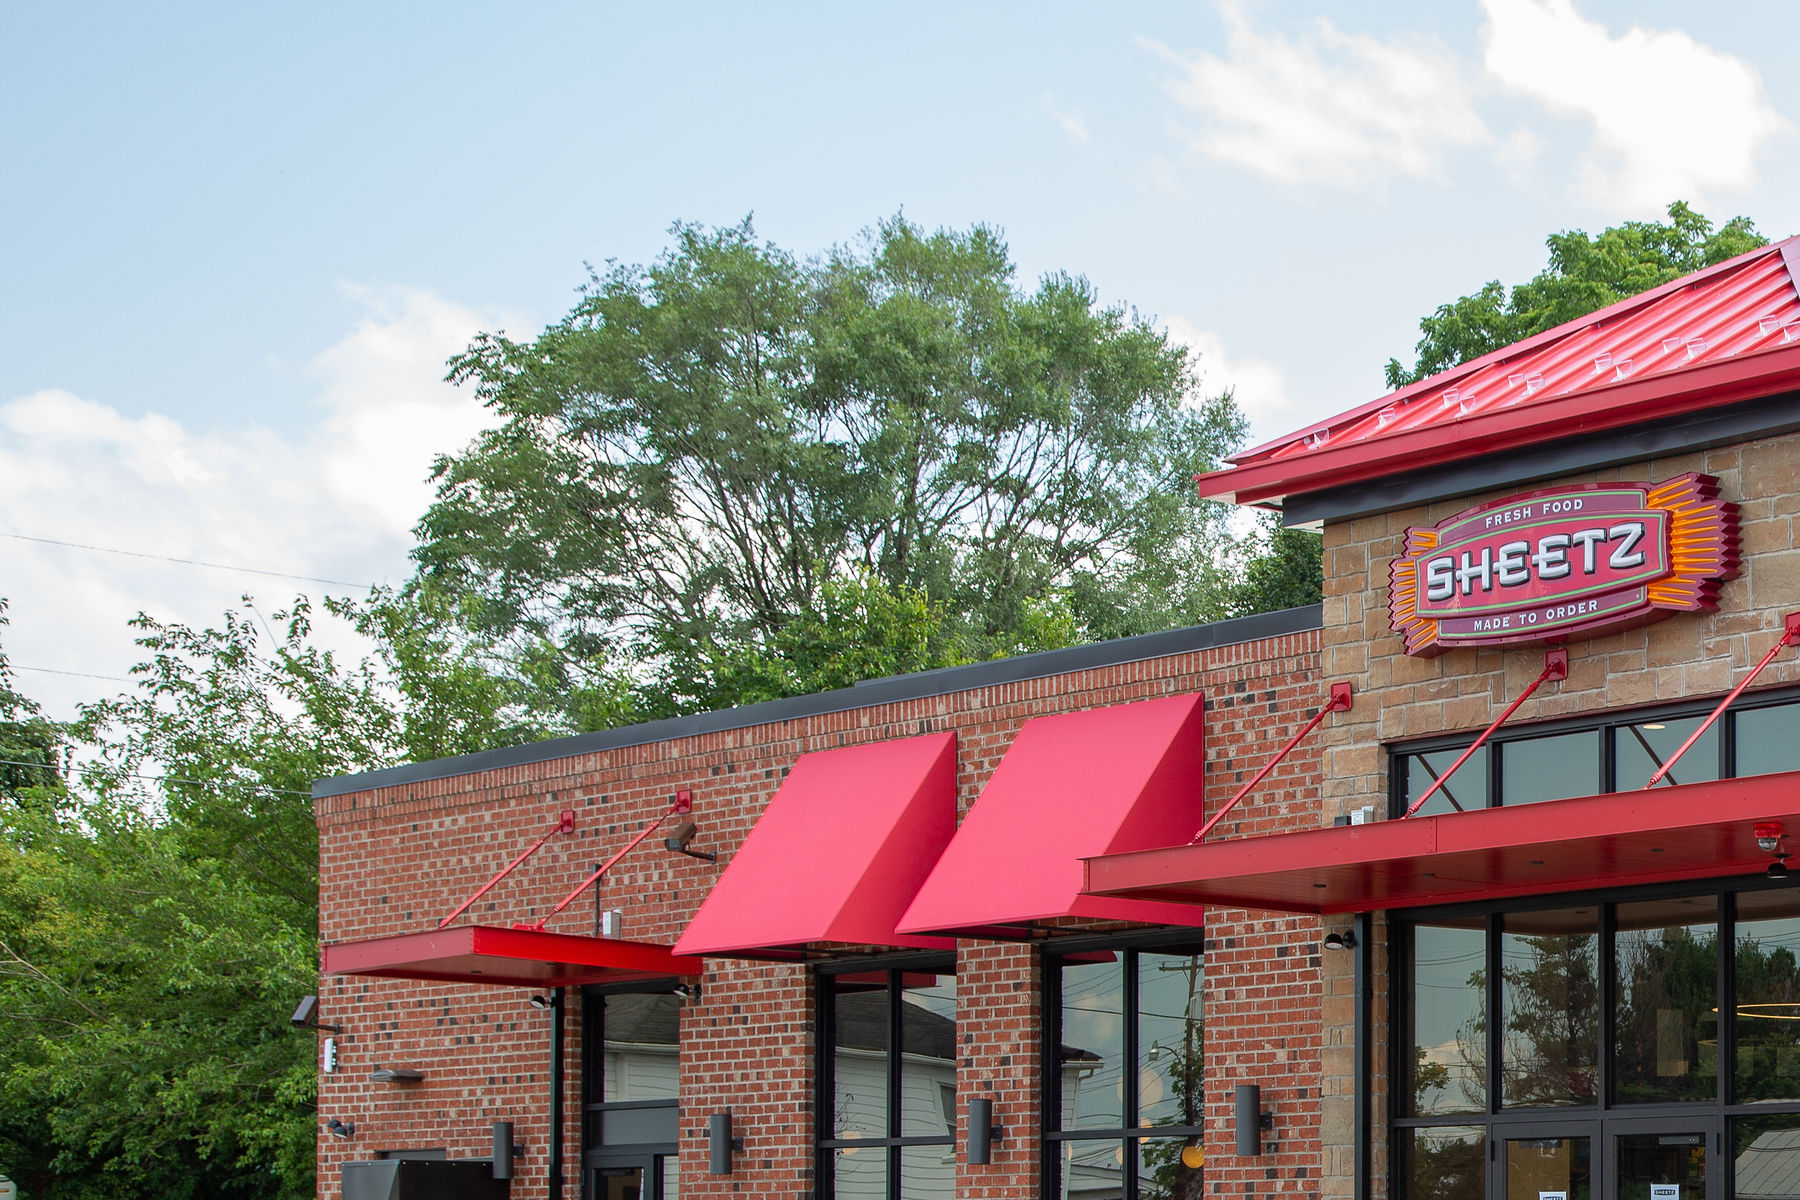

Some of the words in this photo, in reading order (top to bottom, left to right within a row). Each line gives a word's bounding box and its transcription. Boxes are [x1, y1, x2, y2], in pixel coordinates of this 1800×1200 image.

[1485, 506, 1532, 529] FRESH
[1542, 498, 1584, 516] FOOD
[1427, 521, 1647, 602] SHEETZ
[1473, 613, 1516, 632] MADE
[1519, 611, 1538, 626] TO
[1545, 600, 1599, 621] ORDER
